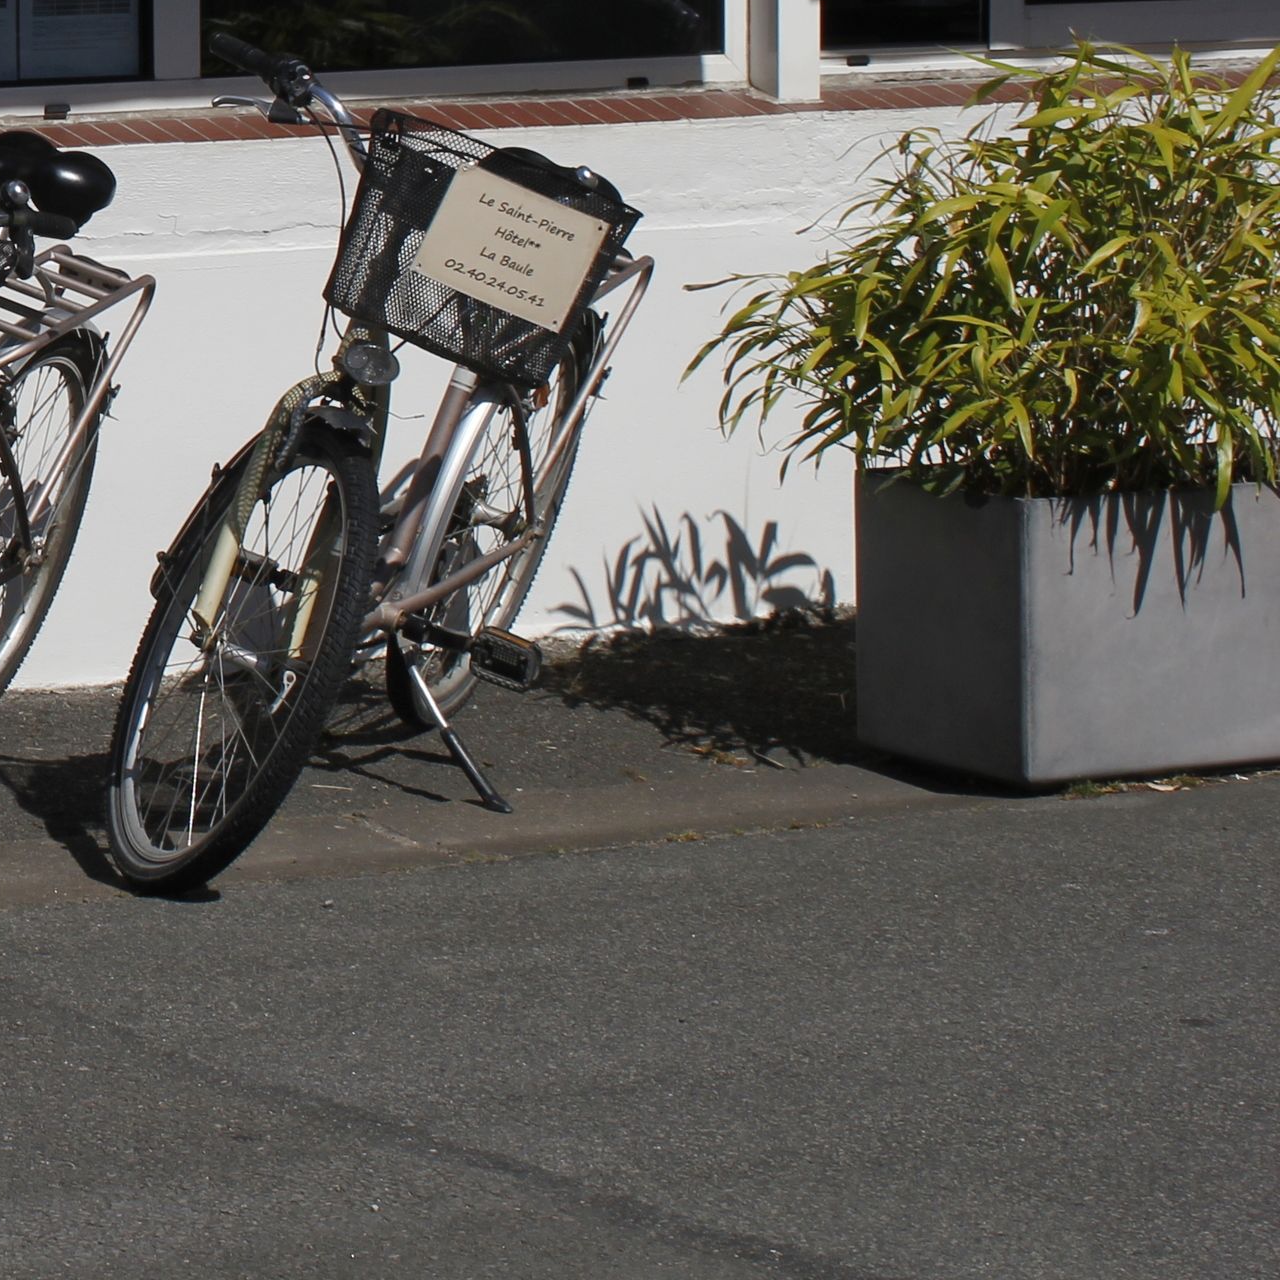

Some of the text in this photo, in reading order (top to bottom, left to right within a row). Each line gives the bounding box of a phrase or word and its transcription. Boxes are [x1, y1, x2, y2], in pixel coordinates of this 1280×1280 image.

[478, 193, 575, 242] Le Saint-Pierre
[479, 246, 534, 277] La Baule
